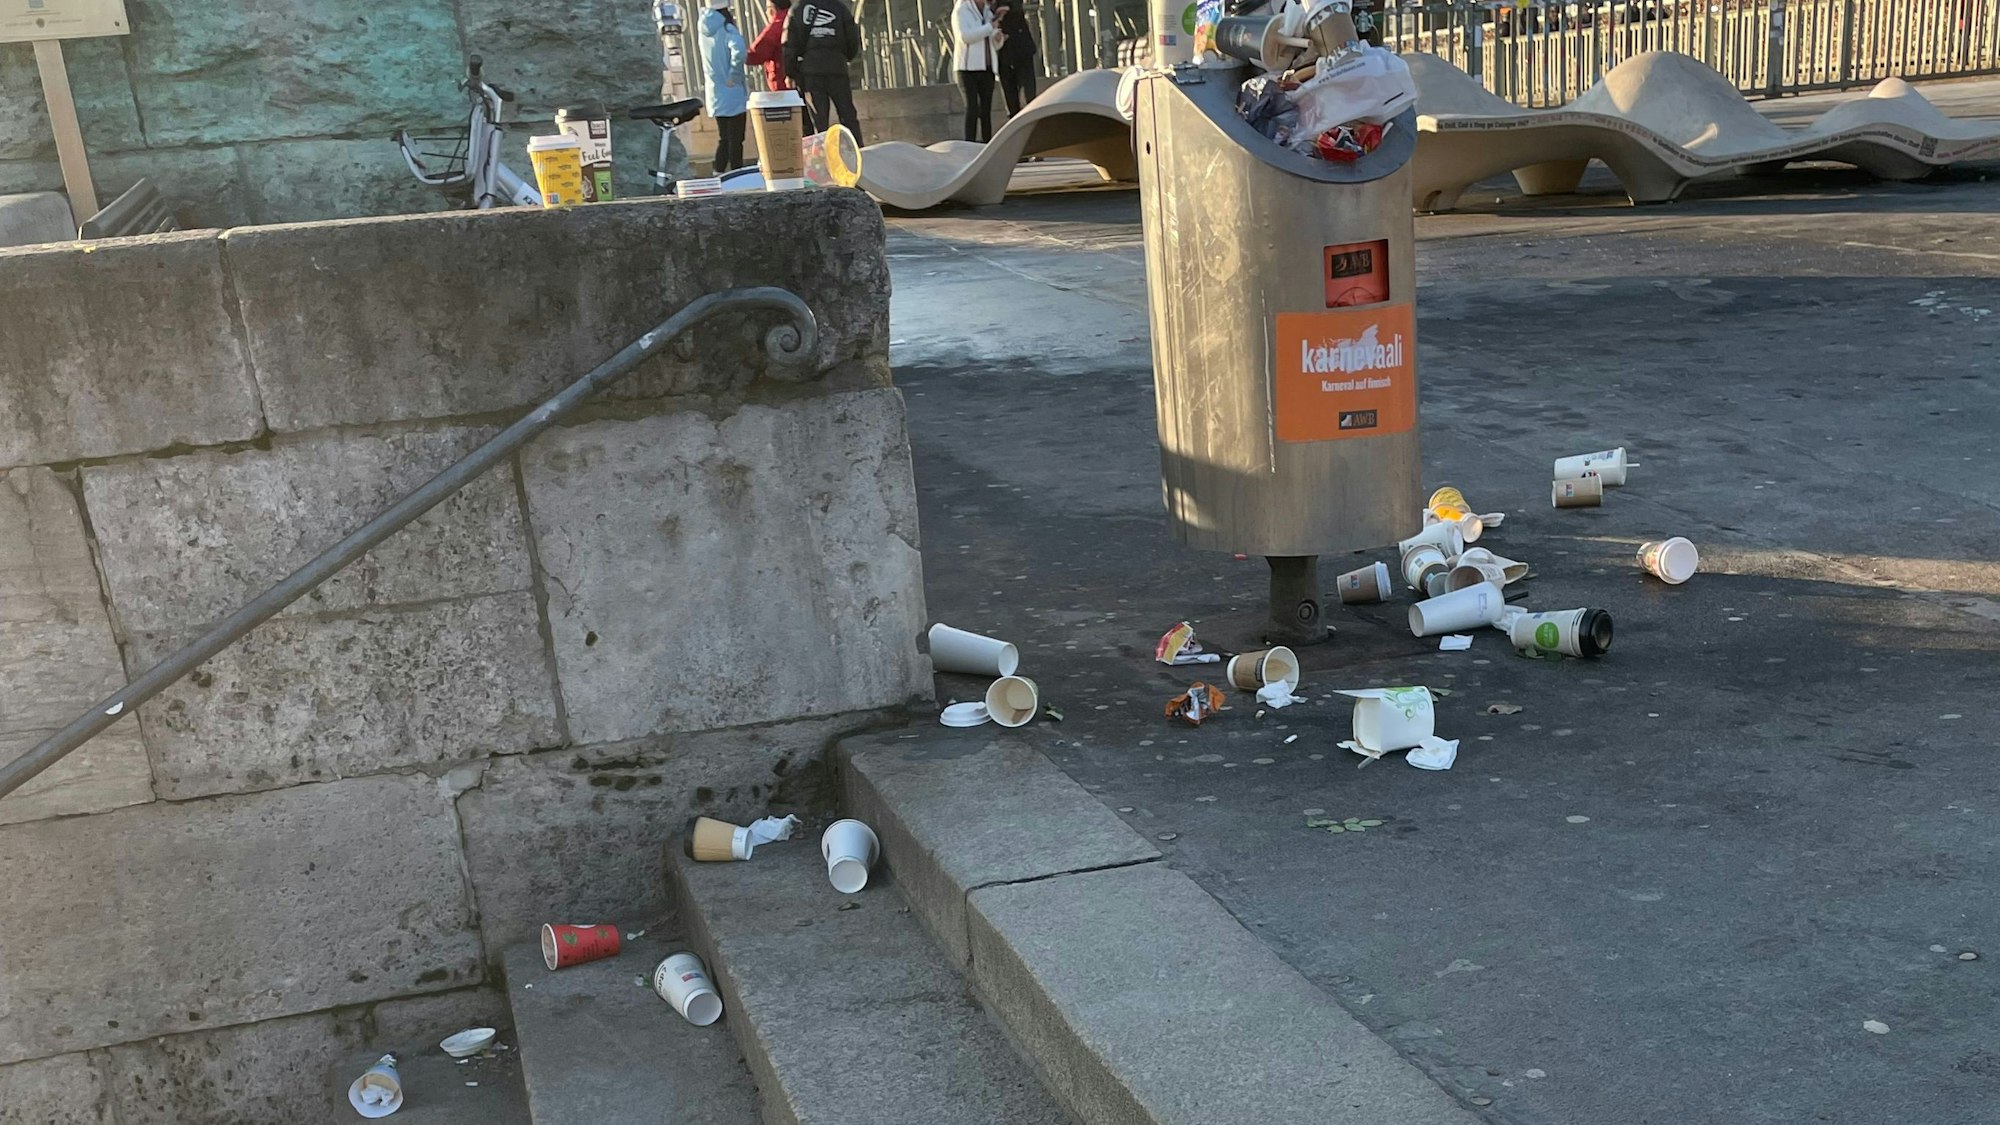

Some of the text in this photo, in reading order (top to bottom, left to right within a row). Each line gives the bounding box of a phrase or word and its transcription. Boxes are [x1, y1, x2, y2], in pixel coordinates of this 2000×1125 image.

[1302, 333, 1402, 373] karnevaali
[1322, 378, 1354, 392] Karneval
[1355, 378, 1367, 391] auf
[1352, 412, 1375, 426] AWB
